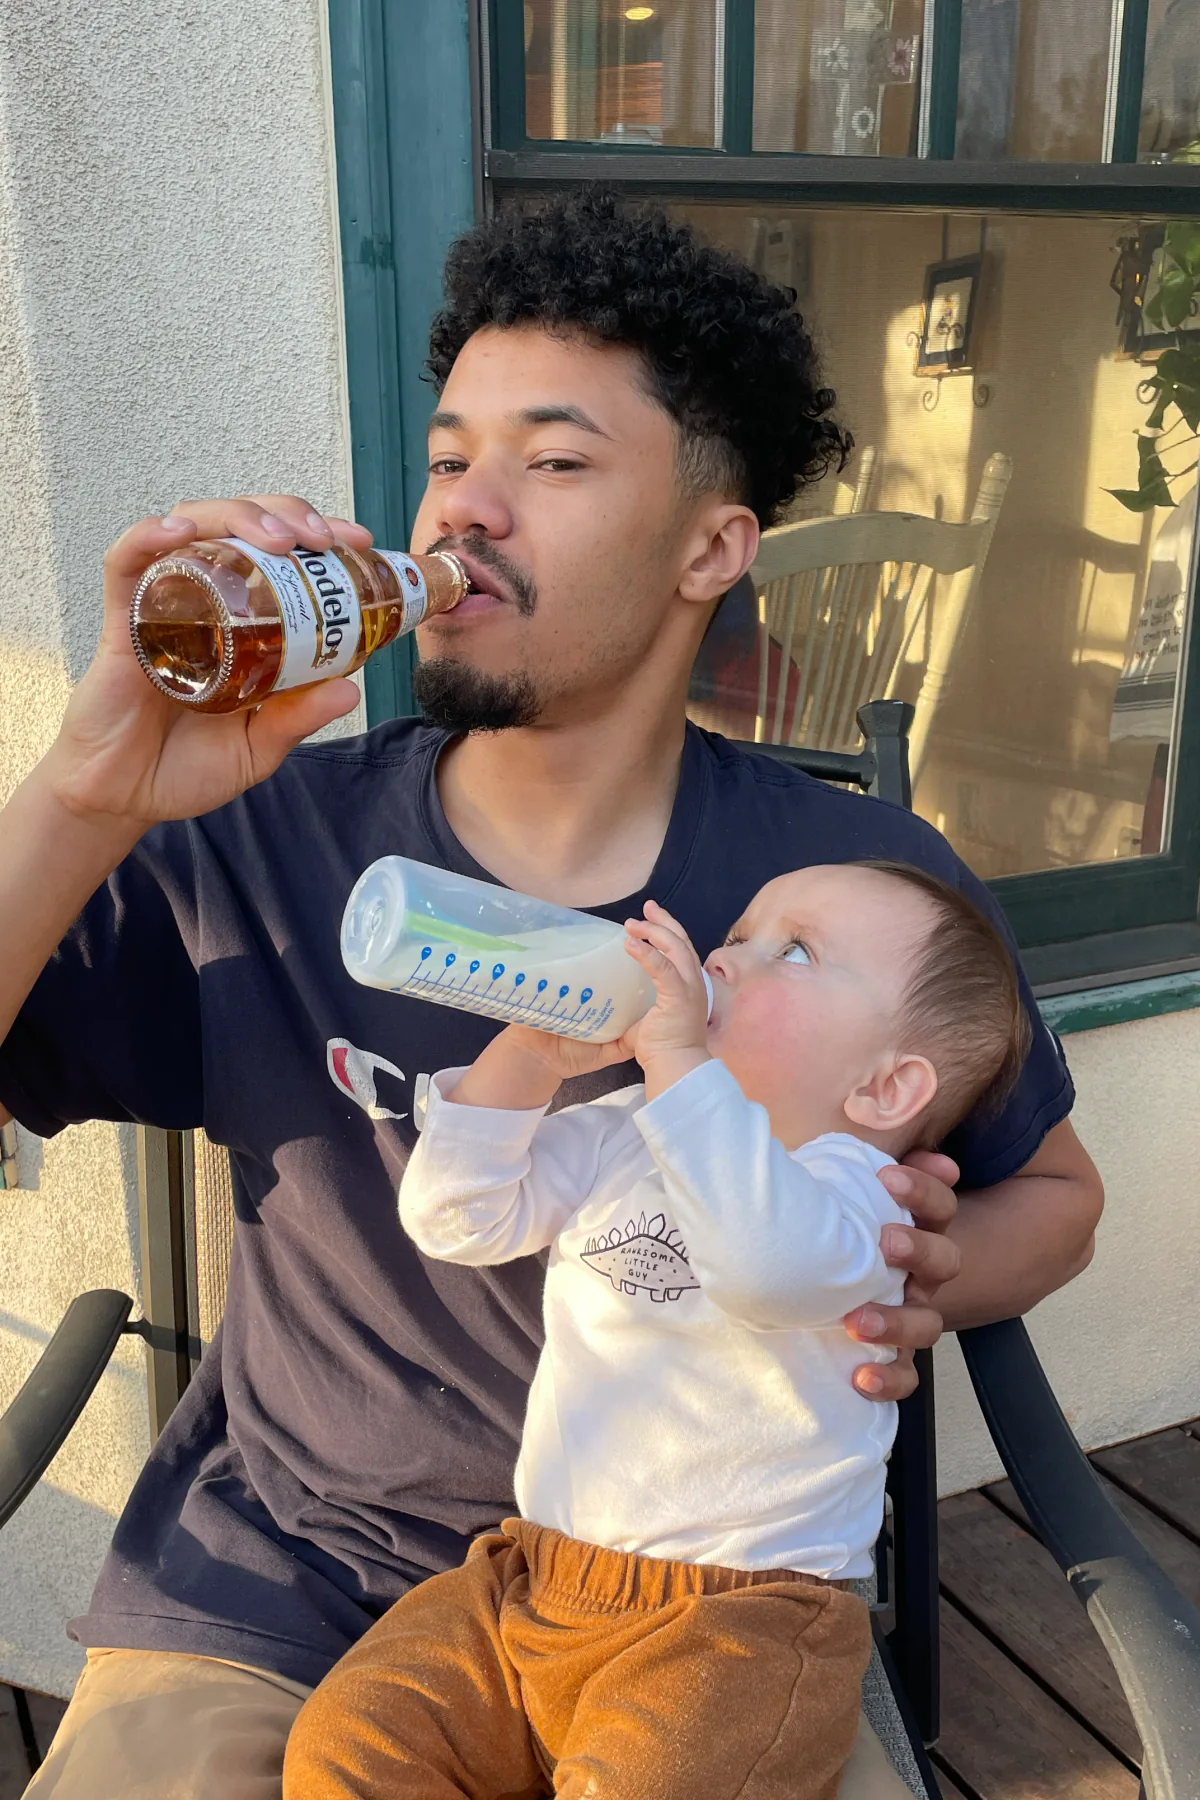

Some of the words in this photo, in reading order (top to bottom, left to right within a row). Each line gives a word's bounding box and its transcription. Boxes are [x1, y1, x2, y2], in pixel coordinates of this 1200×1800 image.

[331, 562, 353, 605] CERVEZA
[620, 1247, 676, 1264] RAWRSOME
[624, 1257, 659, 1272] LITTLE
[628, 1268, 648, 1281] GUY
